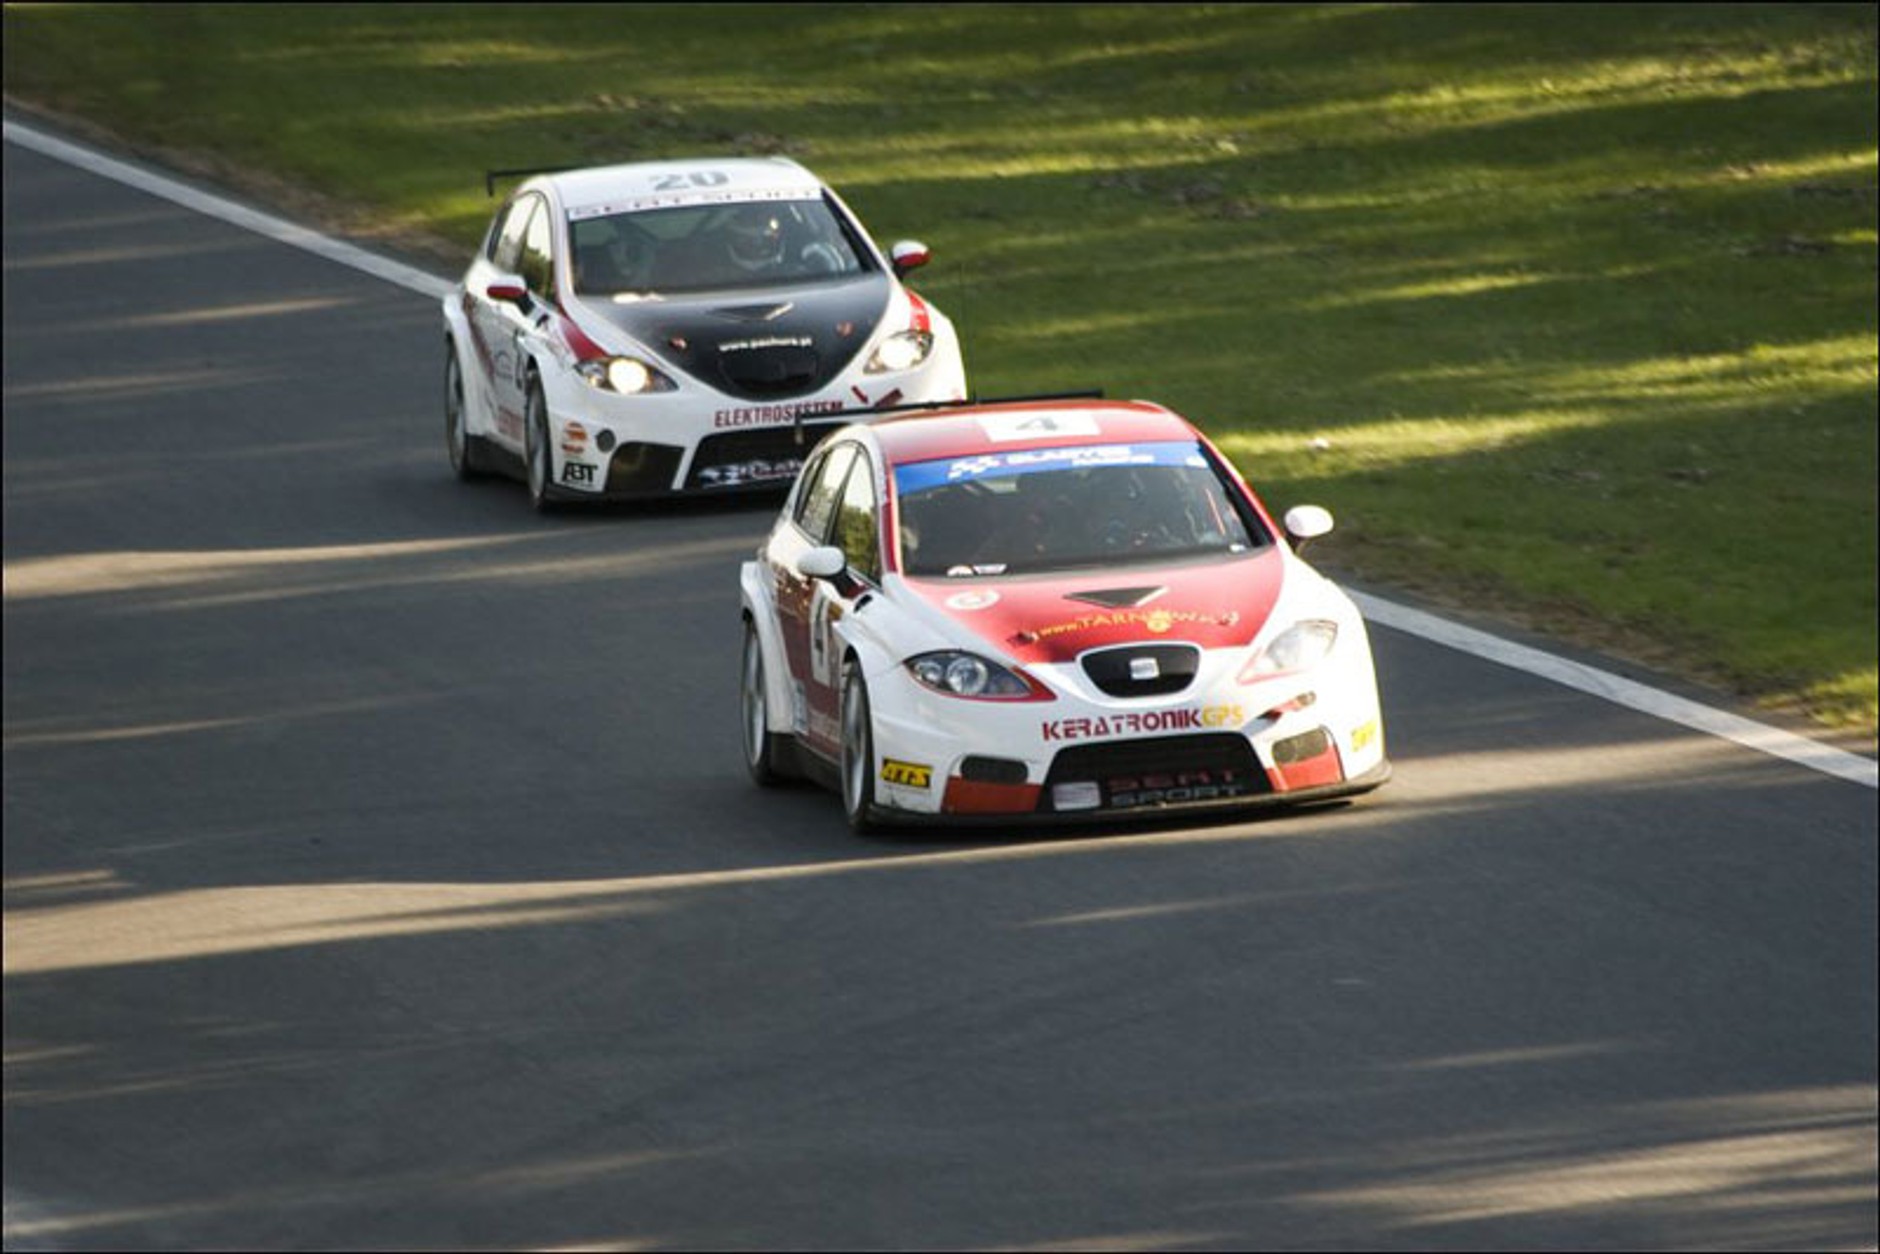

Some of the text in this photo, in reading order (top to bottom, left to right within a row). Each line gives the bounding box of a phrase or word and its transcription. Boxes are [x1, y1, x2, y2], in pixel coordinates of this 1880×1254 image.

[651, 171, 729, 191] 20
[1016, 416, 1058, 431] 4
[562, 462, 598, 482] ABT
